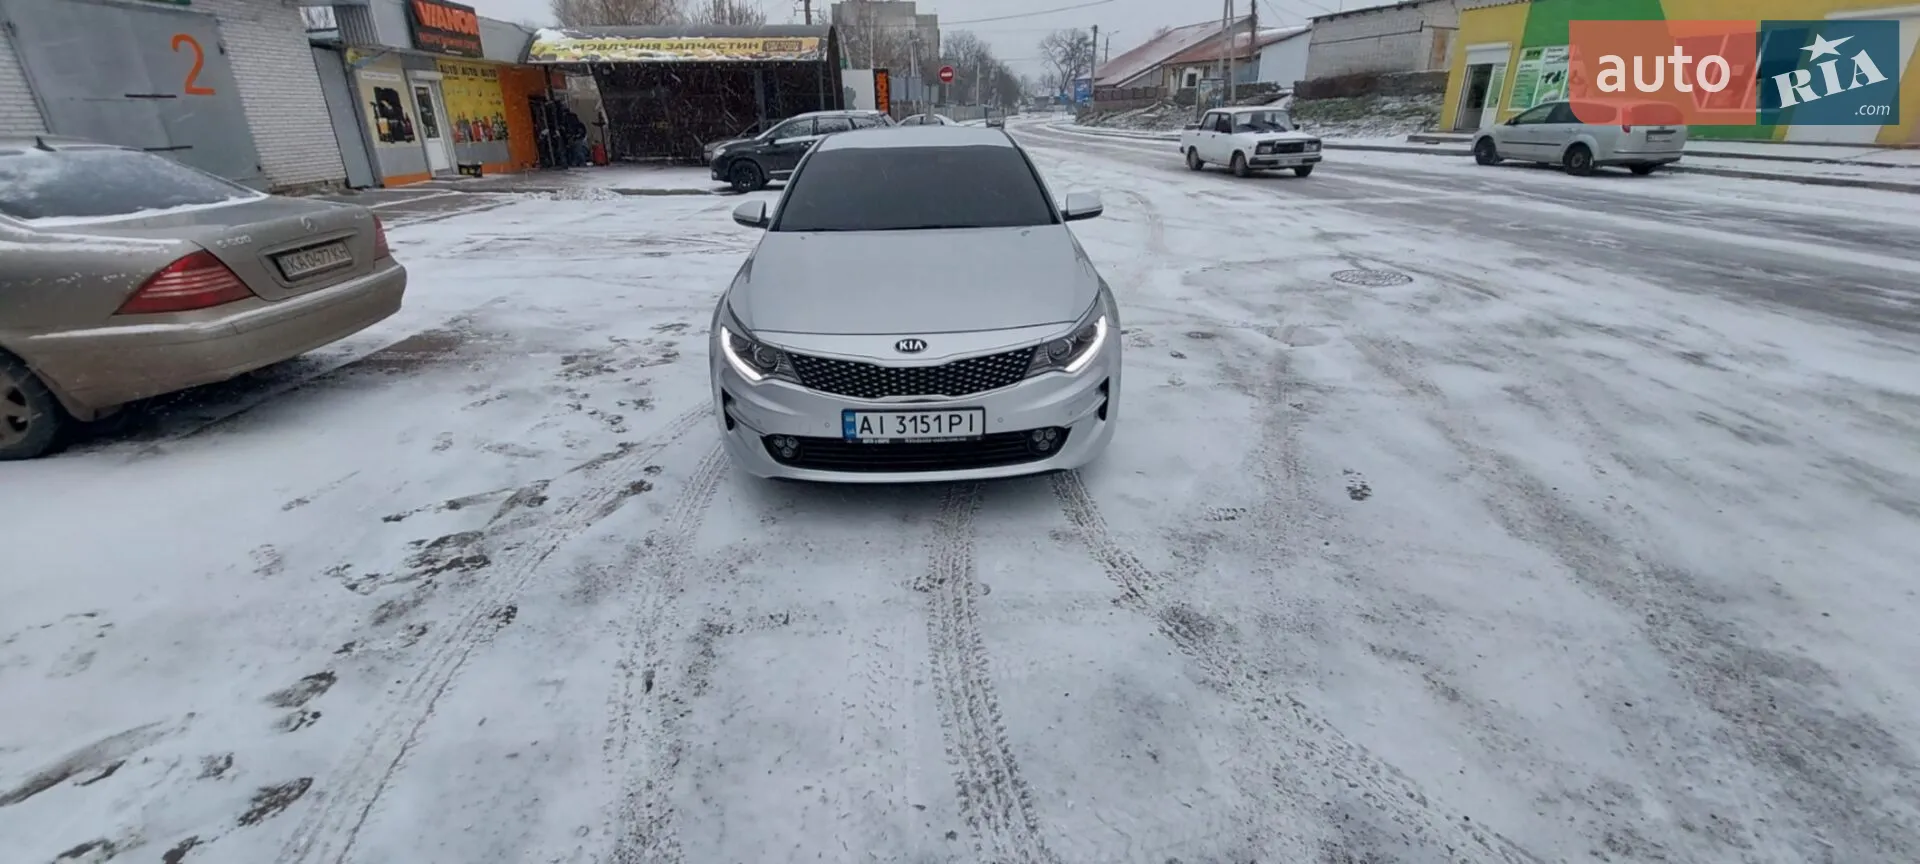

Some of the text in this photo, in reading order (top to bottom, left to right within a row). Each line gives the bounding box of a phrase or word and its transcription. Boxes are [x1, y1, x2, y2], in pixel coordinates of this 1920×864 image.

[665, 41, 759, 50] ЗАПЧАСТИН
[171, 33, 216, 96] 2
[899, 340, 924, 350] KIA
